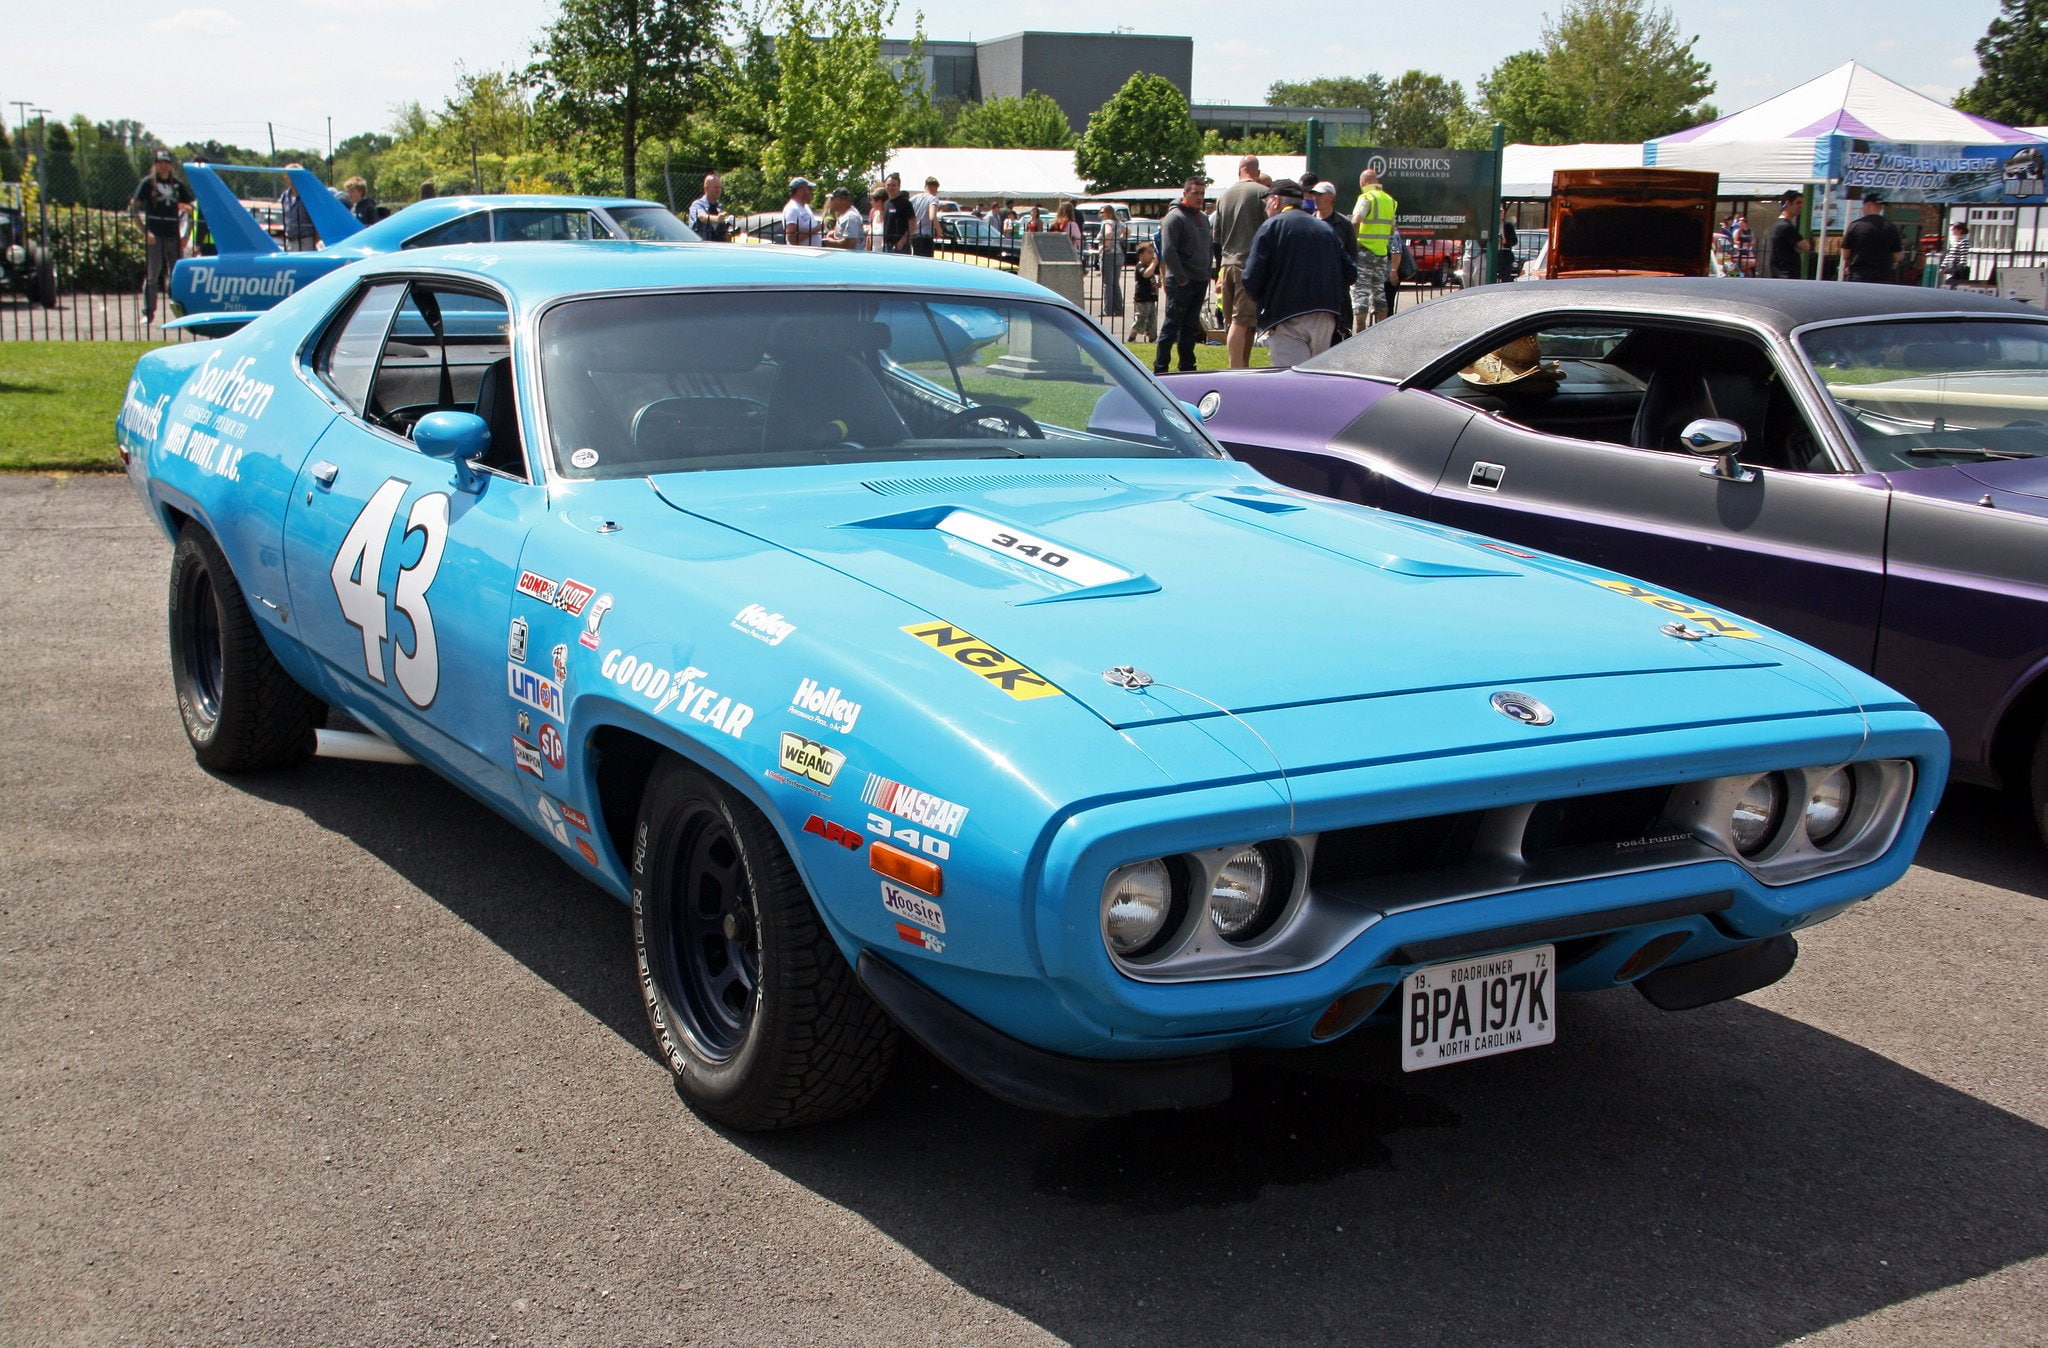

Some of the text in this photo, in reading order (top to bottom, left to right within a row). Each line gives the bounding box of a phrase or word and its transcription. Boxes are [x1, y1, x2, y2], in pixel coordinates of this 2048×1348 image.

[1388, 157, 1451, 171] HISTORICS
[1843, 169, 1945, 189] ASSOCIATION
[1847, 153, 1998, 174] THE MOPAR MUSCLE
[1402, 215, 1422, 224] SPORTS
[1422, 215, 1433, 224] CAR
[1433, 215, 1467, 224] AUCTIONEERS
[189, 266, 297, 304] Plymouth
[224, 302, 248, 312] Petty
[188, 348, 275, 420] Southern
[164, 421, 193, 457] HIGH
[215, 443, 244, 482] N.C.
[990, 533, 1070, 568] 340
[329, 475, 452, 712] 43
[519, 573, 549, 593] COMP
[559, 584, 591, 608] KLOTZ
[735, 603, 798, 647] Holley
[1608, 585, 1748, 632] NGK
[914, 626, 1048, 691] NGK
[601, 648, 754, 739] GOODYEAR
[792, 677, 862, 734] Holley
[515, 745, 542, 769] CHAMPION
[542, 726, 563, 763] STP
[785, 745, 834, 776] WEIAND
[889, 783, 964, 836] NASCAR
[801, 814, 864, 851] ARP
[866, 813, 951, 861] 340
[1616, 831, 1694, 848] road runner
[885, 886, 941, 924] Hoosier
[633, 821, 687, 1077] GRABBER HP
[1535, 953, 1547, 968] 72
[1451, 959, 1514, 984] ROADRUNNER
[1410, 969, 1549, 1047] BPA 197K
[1438, 1030, 1522, 1059] NORTH CAROLINA
